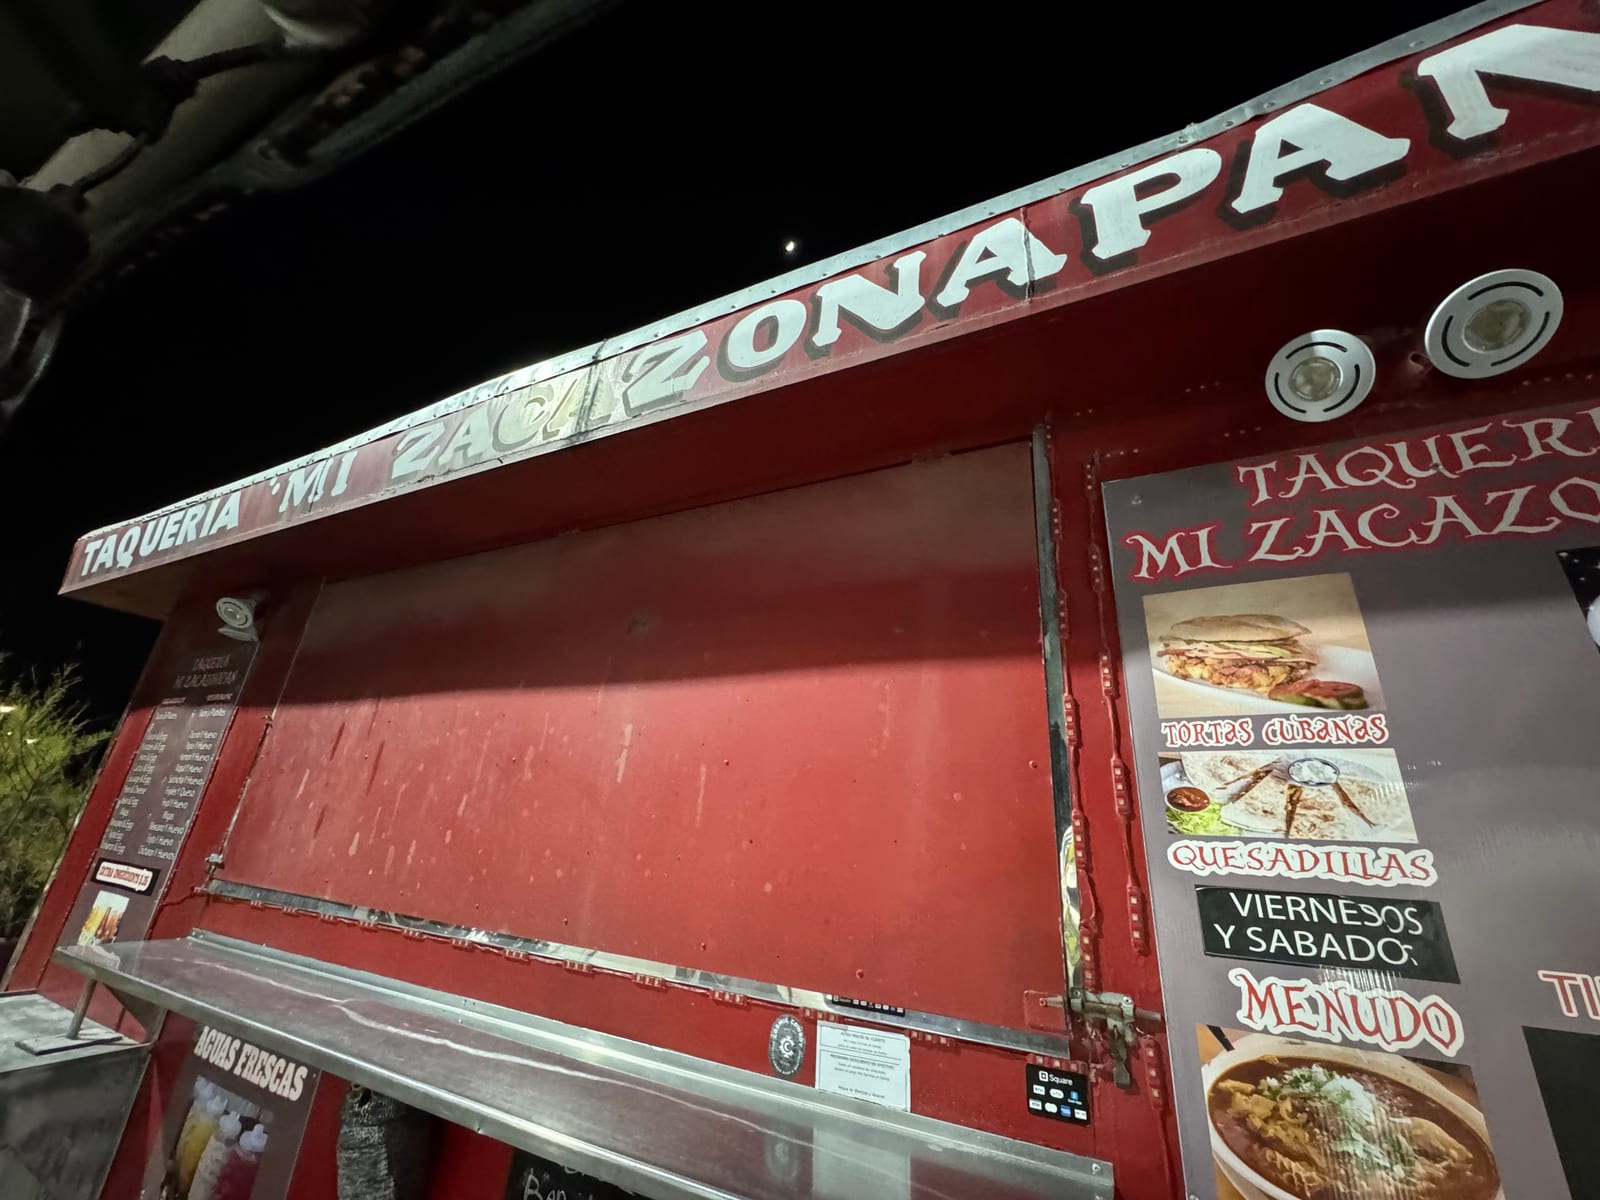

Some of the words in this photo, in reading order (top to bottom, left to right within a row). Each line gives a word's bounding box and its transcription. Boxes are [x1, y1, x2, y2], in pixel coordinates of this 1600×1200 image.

[81, 491, 241, 577] TAQUERIA
[1126, 525, 1233, 580] MI
[1262, 715, 1388, 746] CUBANAS
[1172, 844, 1431, 881] QUESADILLAS
[1214, 923, 1236, 949] Y
[1236, 973, 1457, 1049] MENUDO
[194, 1026, 242, 1071] AGUAS
[233, 1043, 308, 1101] FRESCAS
[1049, 1074, 1073, 1086] Square
